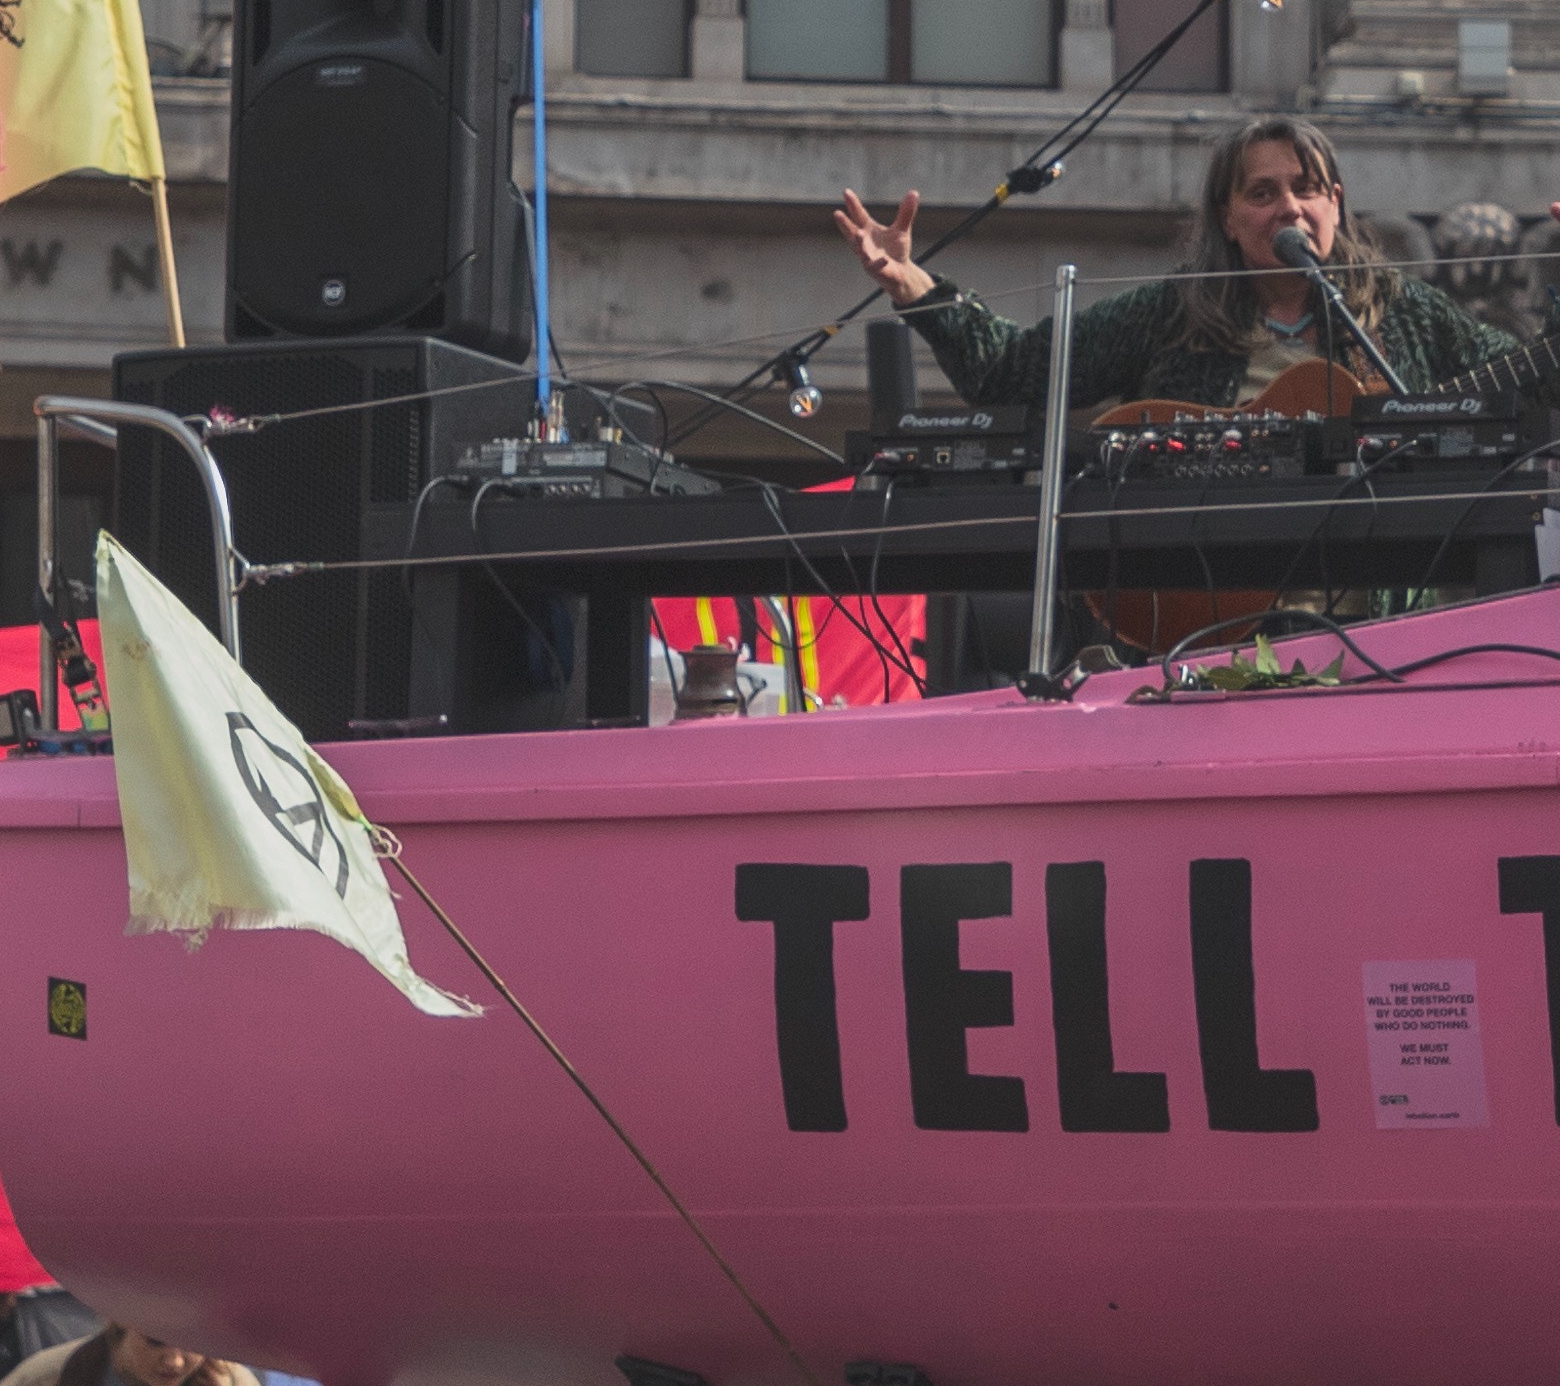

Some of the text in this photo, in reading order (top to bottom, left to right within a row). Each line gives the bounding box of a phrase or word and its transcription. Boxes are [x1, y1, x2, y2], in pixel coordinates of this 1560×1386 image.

[1382, 399, 1458, 413] Pioneer
[898, 413, 970, 428] Pioneer
[1390, 982, 1451, 992] THE WORLD
[734, 858, 1320, 1134] TELL
[1367, 994, 1474, 1006] WILL BE DESTROYED
[1376, 1007, 1467, 1018] BY GOOD PEOPLE
[1374, 1022, 1400, 1031] WHO
[1403, 1021, 1418, 1030] DO
[1400, 1043, 1449, 1053] WE MUST
[1400, 1056, 1421, 1065] ACT
